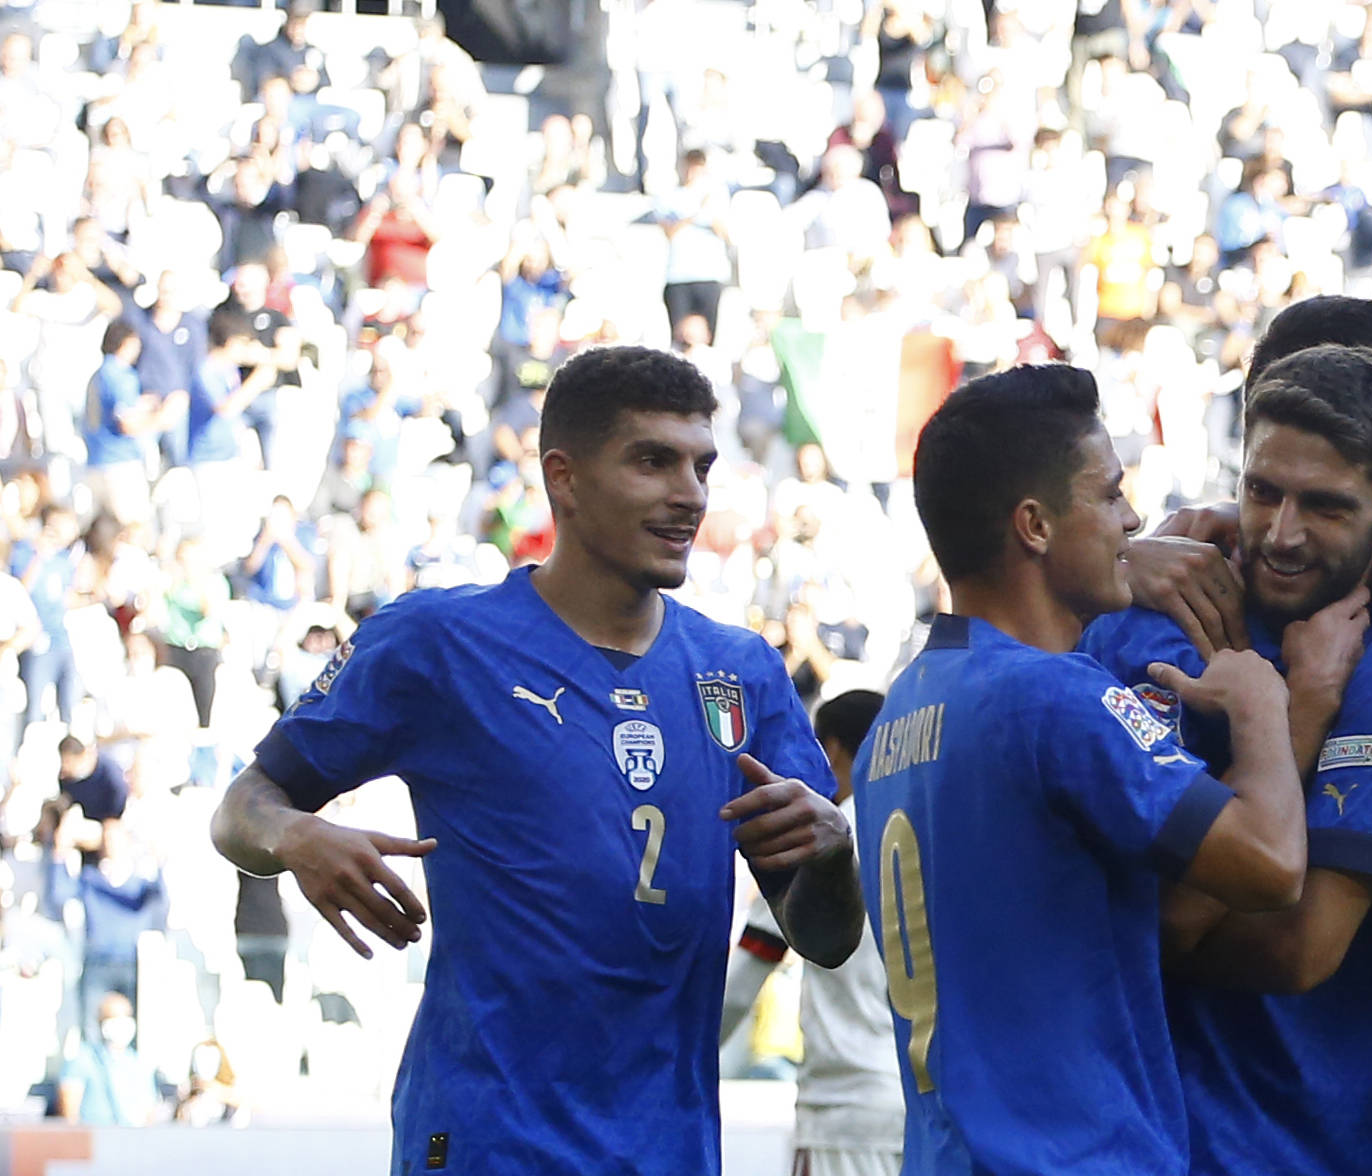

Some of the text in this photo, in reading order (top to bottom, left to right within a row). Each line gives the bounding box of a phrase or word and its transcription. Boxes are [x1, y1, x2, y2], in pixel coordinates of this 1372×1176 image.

[702, 685, 739, 700] ITALIA
[632, 804, 665, 904] 2
[880, 808, 938, 1094] 9
